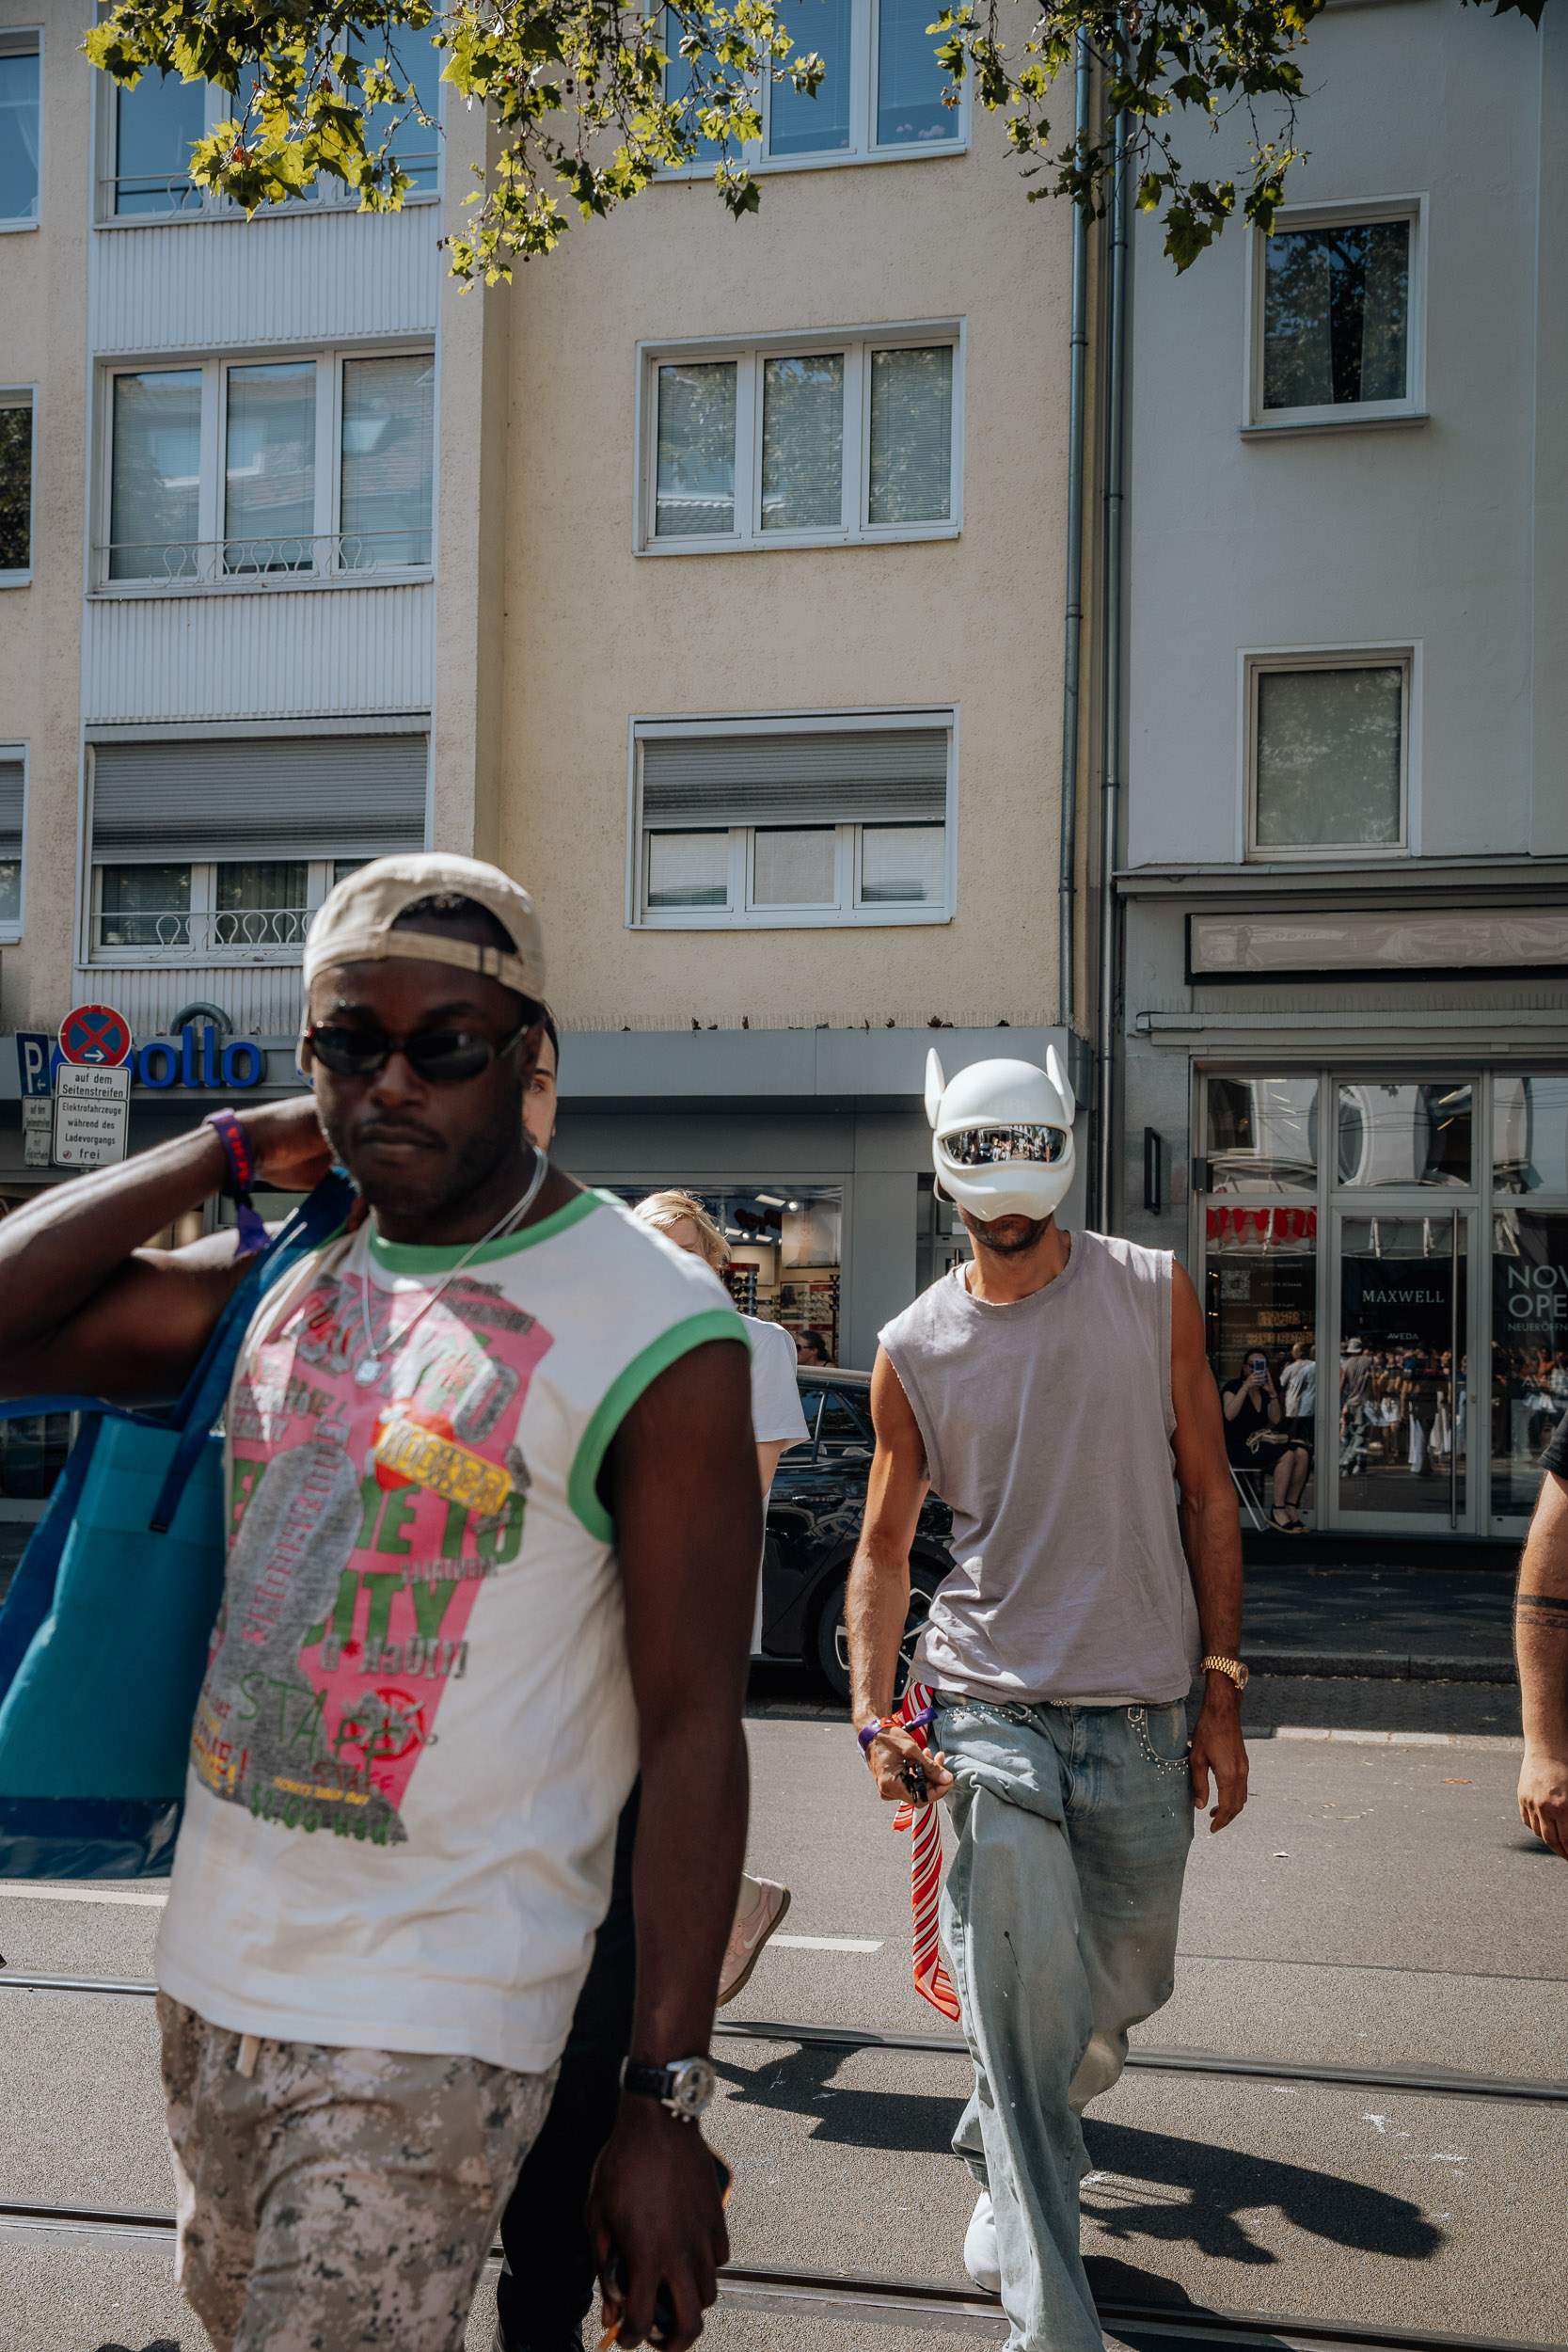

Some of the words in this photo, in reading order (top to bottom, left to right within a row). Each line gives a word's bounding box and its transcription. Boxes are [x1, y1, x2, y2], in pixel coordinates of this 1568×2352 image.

[24, 1041, 43, 1094] P
[74, 1073, 90, 1083] auf
[93, 1073, 113, 1085] dem
[62, 1084, 124, 1099] Seitenstreifen
[62, 1102, 122, 1117] Elektrofahrzeuge
[68, 1119, 100, 1129] während
[102, 1120, 116, 1130] des
[65, 1133, 117, 1147] Ladevorgangs
[79, 1148, 101, 1160] frei
[1361, 1289, 1446, 1303] MAXWELL
[1386, 1332, 1420, 1341] AVEDA
[303, 1569, 459, 1654] ITY
[238, 1672, 403, 1788] STAFF
